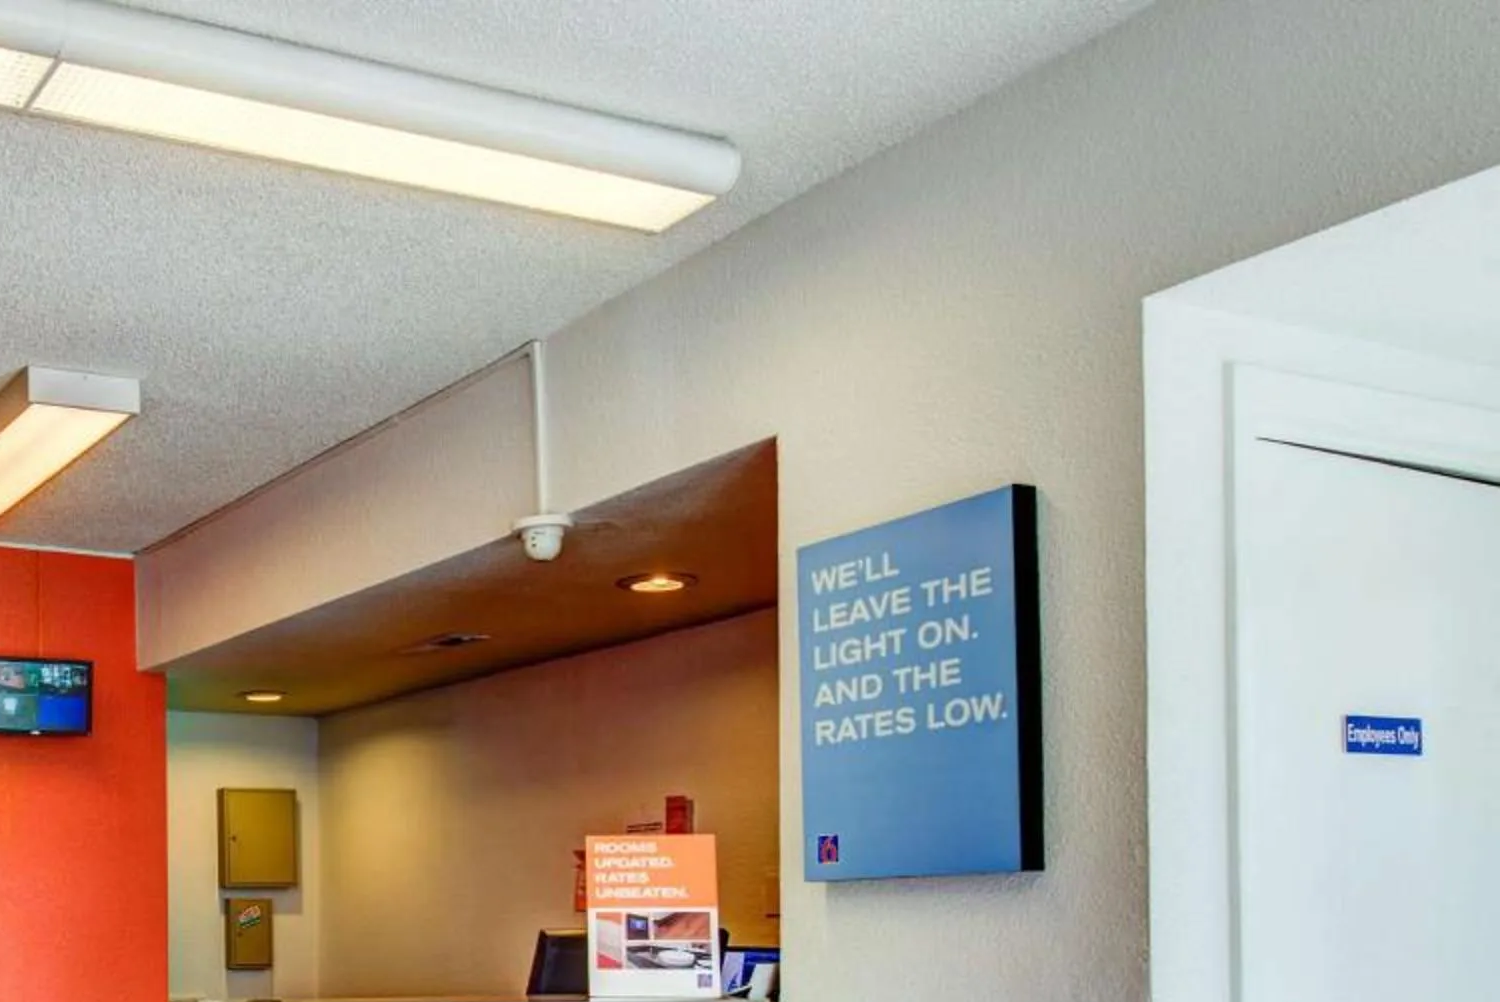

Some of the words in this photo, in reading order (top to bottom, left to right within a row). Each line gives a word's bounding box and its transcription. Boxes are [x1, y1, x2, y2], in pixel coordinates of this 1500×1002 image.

[811, 552, 899, 595] WE'LL
[813, 587, 911, 633] LEAVE
[920, 567, 993, 608] THE
[813, 628, 907, 670] LIGHT
[918, 615, 979, 650] ON.
[814, 673, 883, 708] AND
[893, 658, 961, 694] THE
[815, 706, 916, 746] RATES
[927, 692, 1009, 731] LOW.
[1347, 723, 1396, 748] Employees
[1397, 725, 1419, 750] Only
[594, 841, 658, 854] ROOMS
[595, 871, 650, 884] RATES
